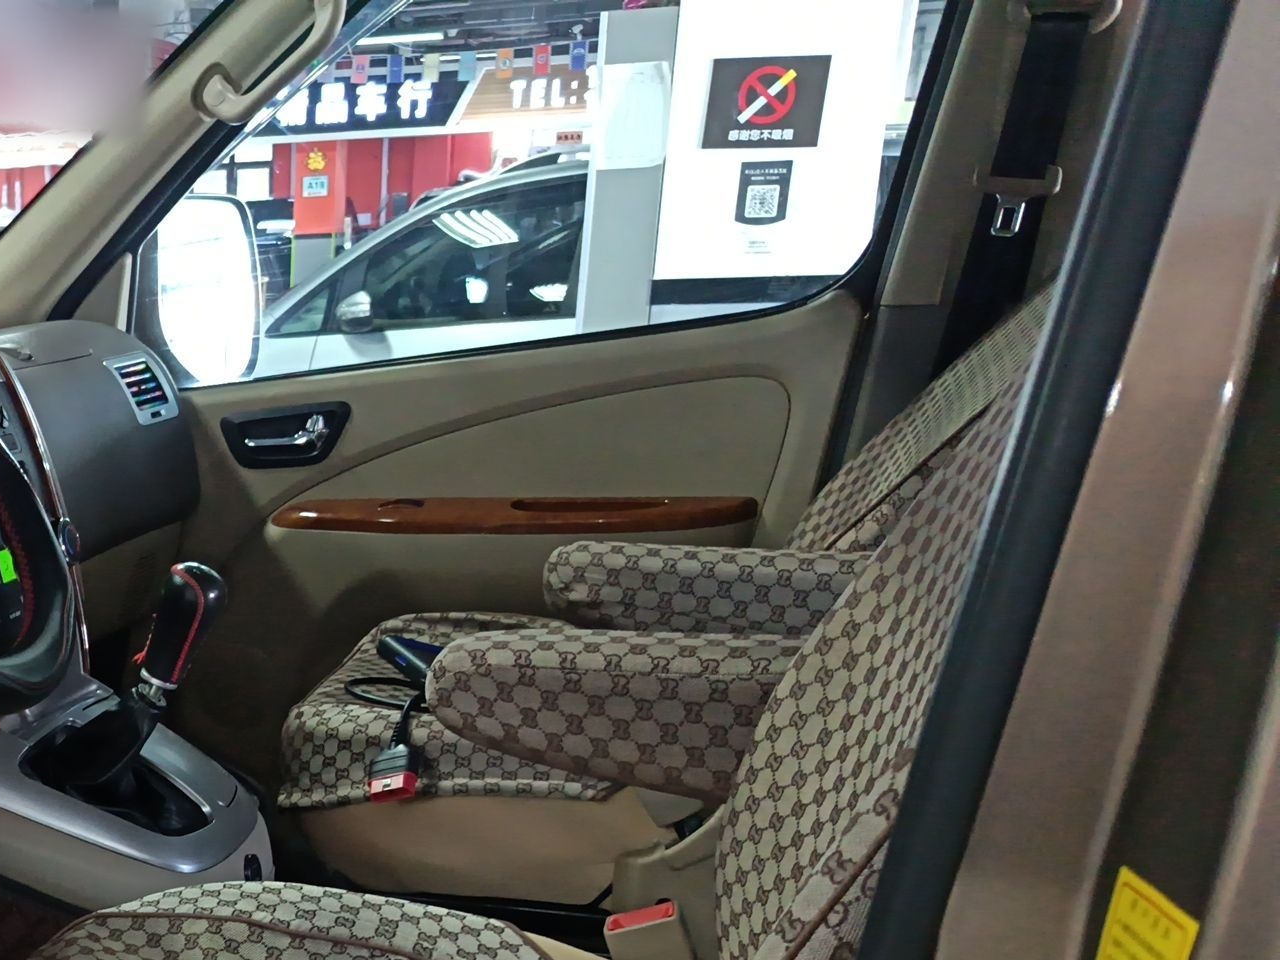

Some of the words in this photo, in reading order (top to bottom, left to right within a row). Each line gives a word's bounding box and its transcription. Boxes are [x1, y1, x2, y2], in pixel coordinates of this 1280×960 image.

[727, 128, 794, 141] 感谢您不吸烟
